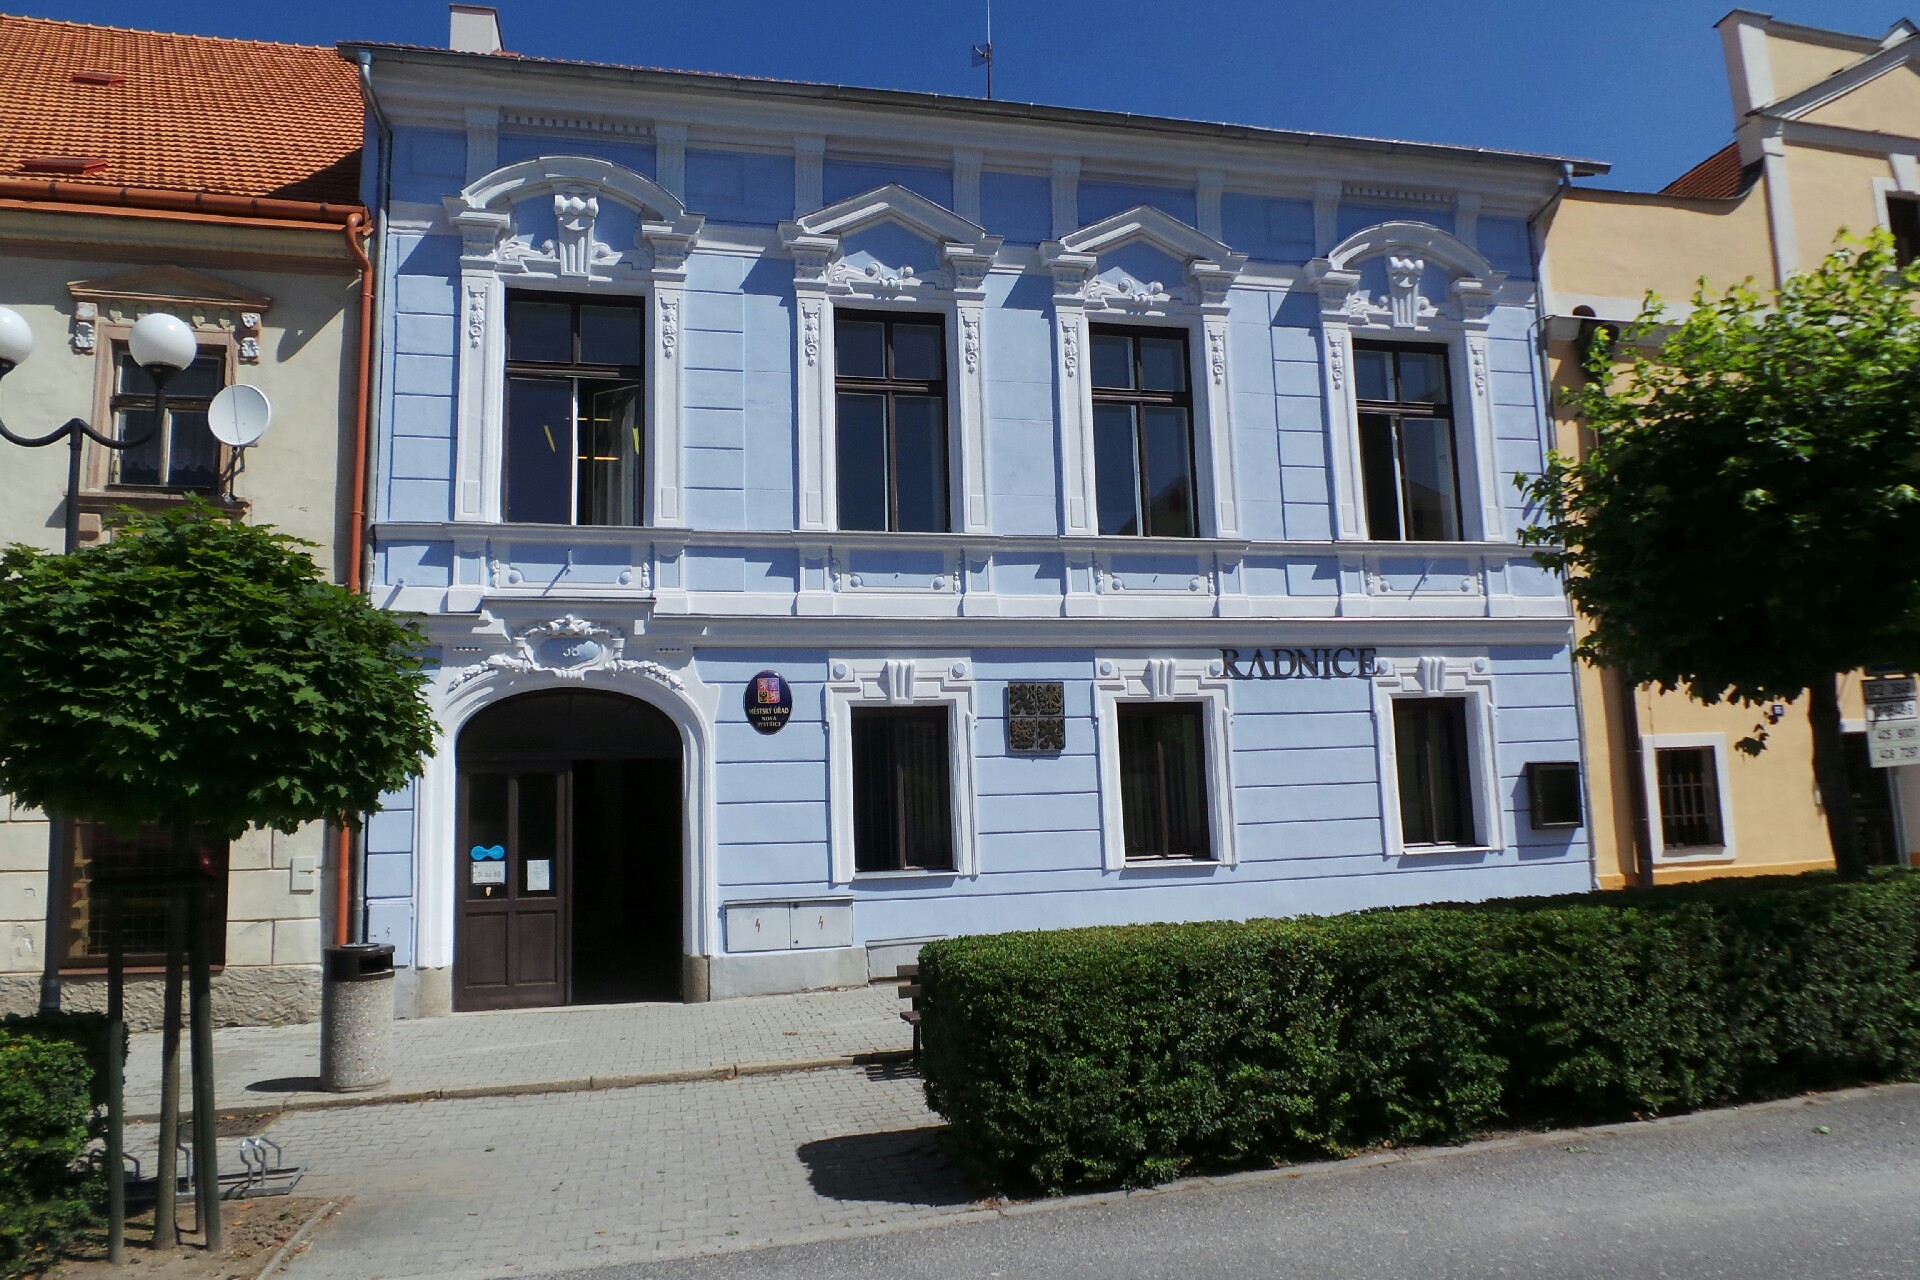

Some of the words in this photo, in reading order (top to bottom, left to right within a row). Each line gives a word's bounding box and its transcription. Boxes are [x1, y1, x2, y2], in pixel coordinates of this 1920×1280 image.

[1219, 648, 1379, 678] RADNICE
[749, 706, 772, 714] MĚSTSKÝ
[773, 705, 789, 714] ÚŘAD
